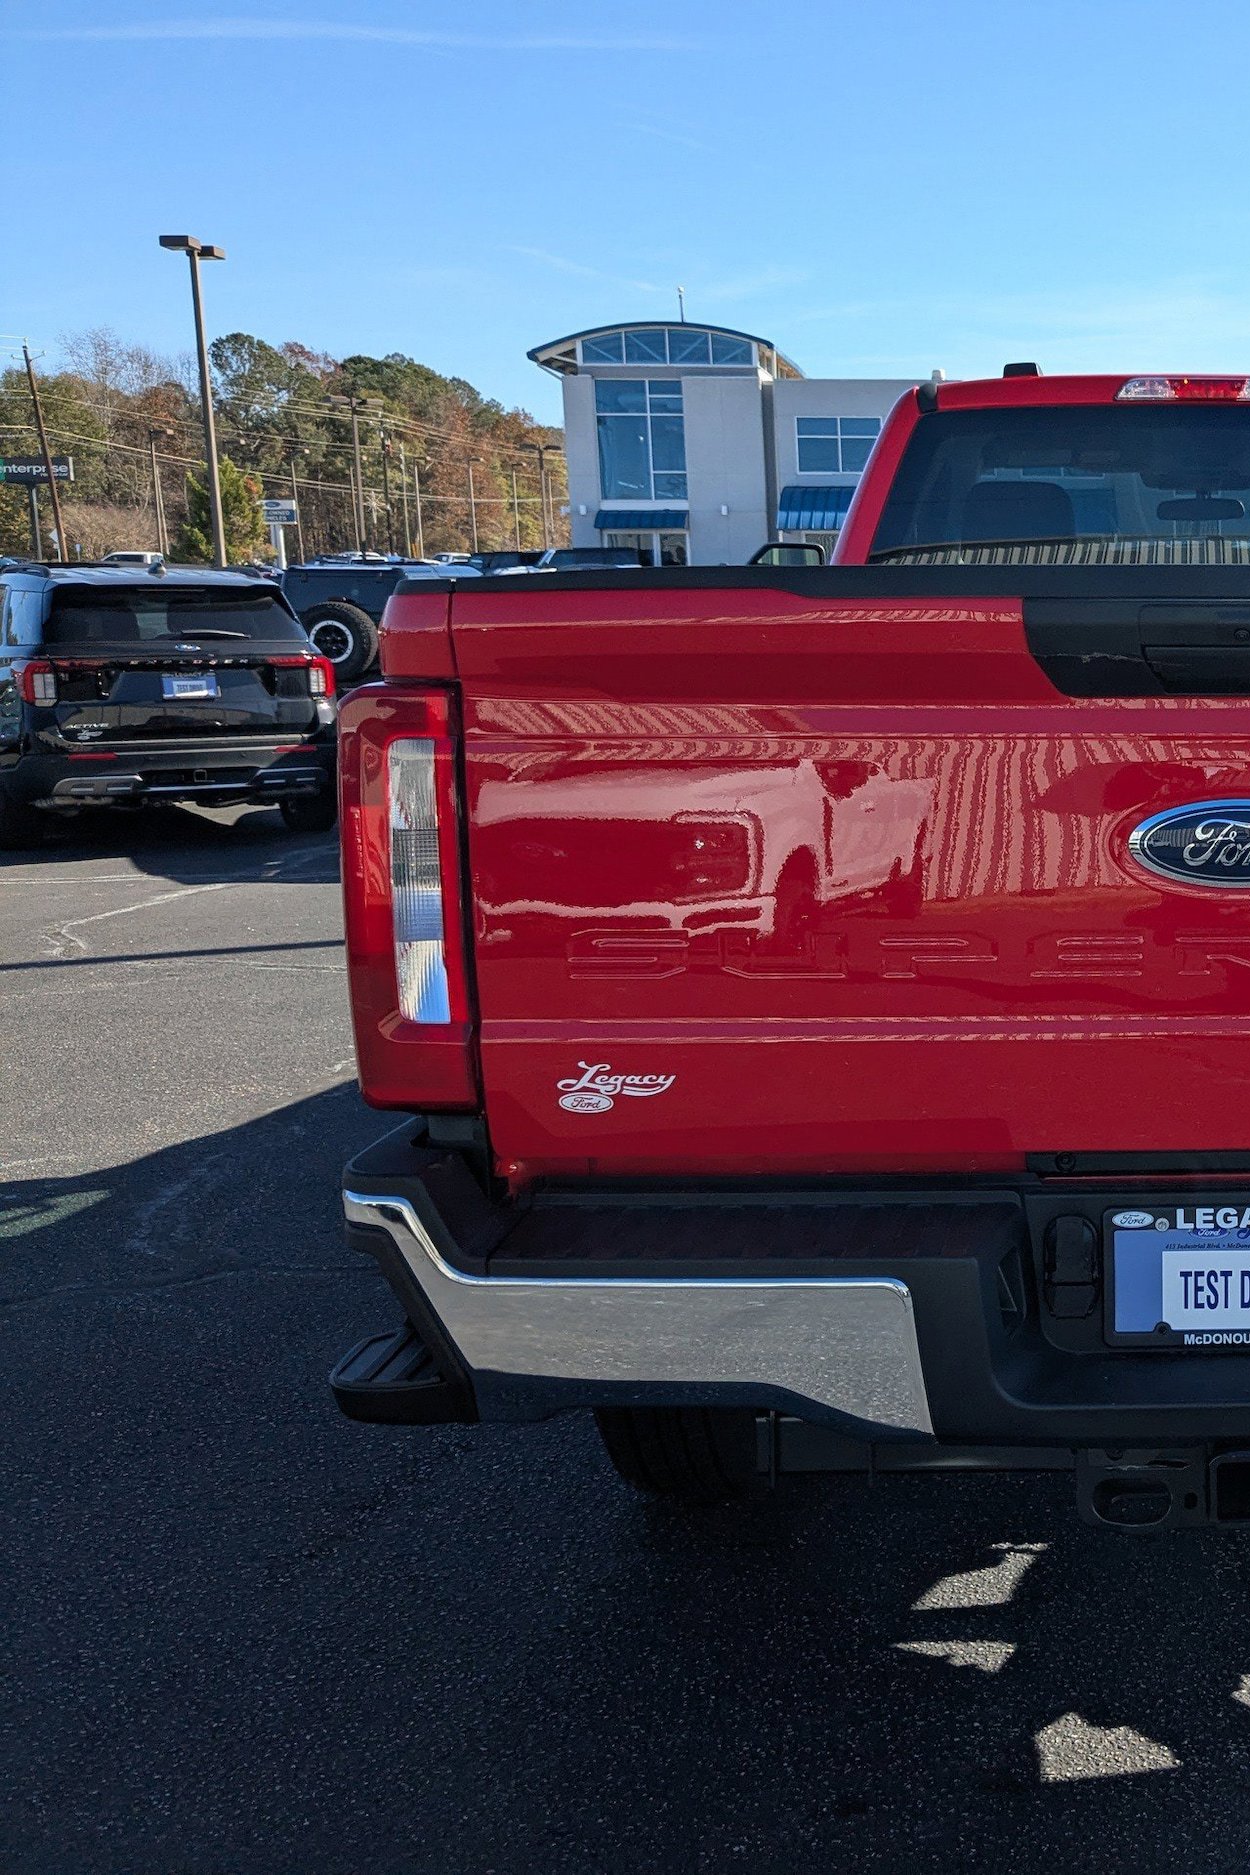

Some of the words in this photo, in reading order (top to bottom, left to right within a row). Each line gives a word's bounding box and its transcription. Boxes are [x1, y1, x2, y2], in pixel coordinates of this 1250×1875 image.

[0, 464, 69, 476] nterprse
[557, 1061, 677, 1097] Legacy
[570, 1096, 601, 1109] Ford
[1119, 1214, 1146, 1226] Ford
[1180, 1270, 1233, 1310] TEST
